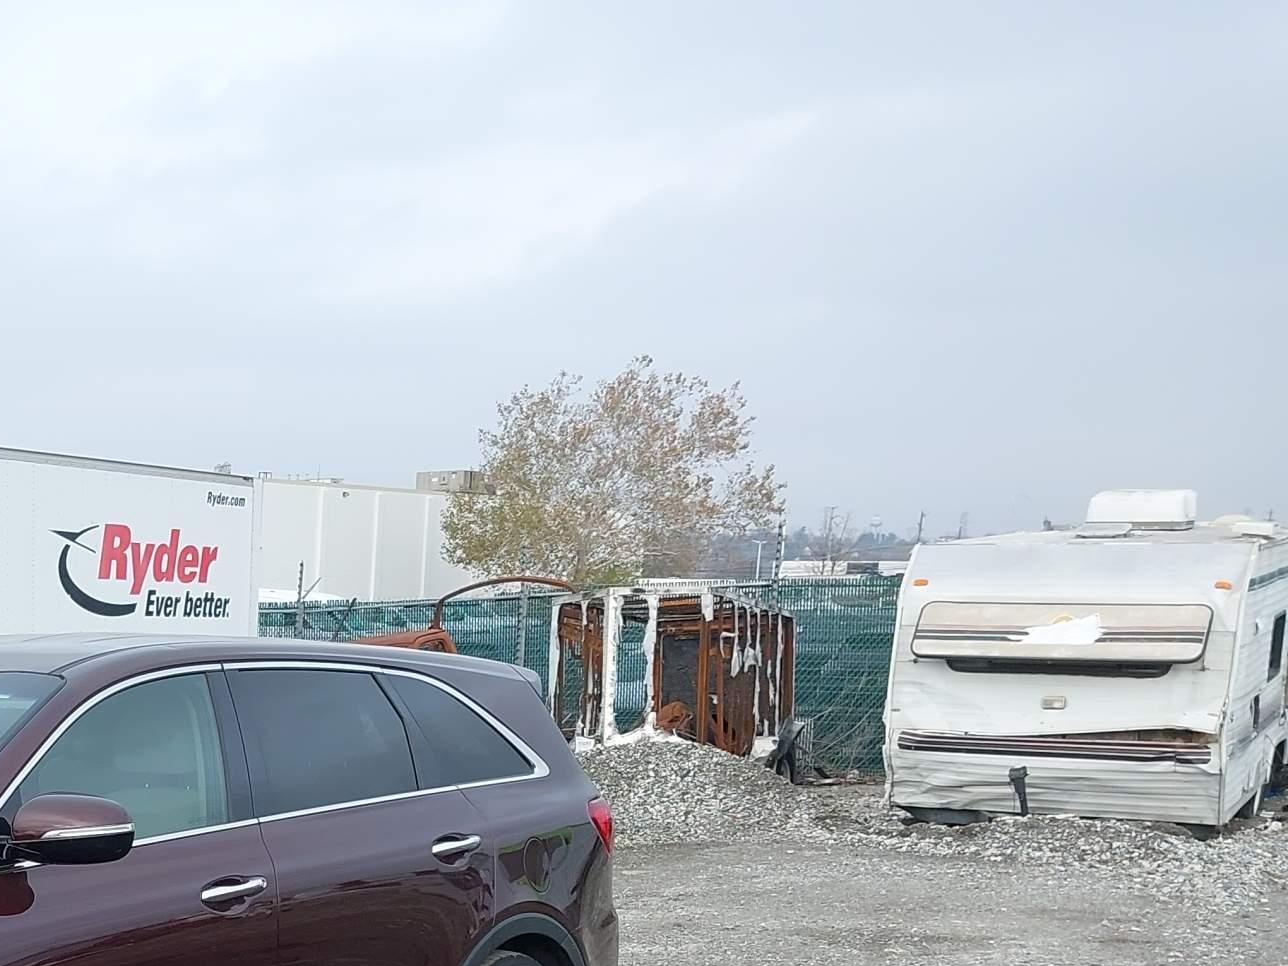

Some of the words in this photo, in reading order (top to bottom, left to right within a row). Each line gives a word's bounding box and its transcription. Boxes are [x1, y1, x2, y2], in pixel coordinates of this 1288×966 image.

[206, 491, 246, 507] Ryder.com
[98, 523, 219, 595] Ryder
[144, 589, 181, 617] Ever
[183, 591, 230, 618] better.
